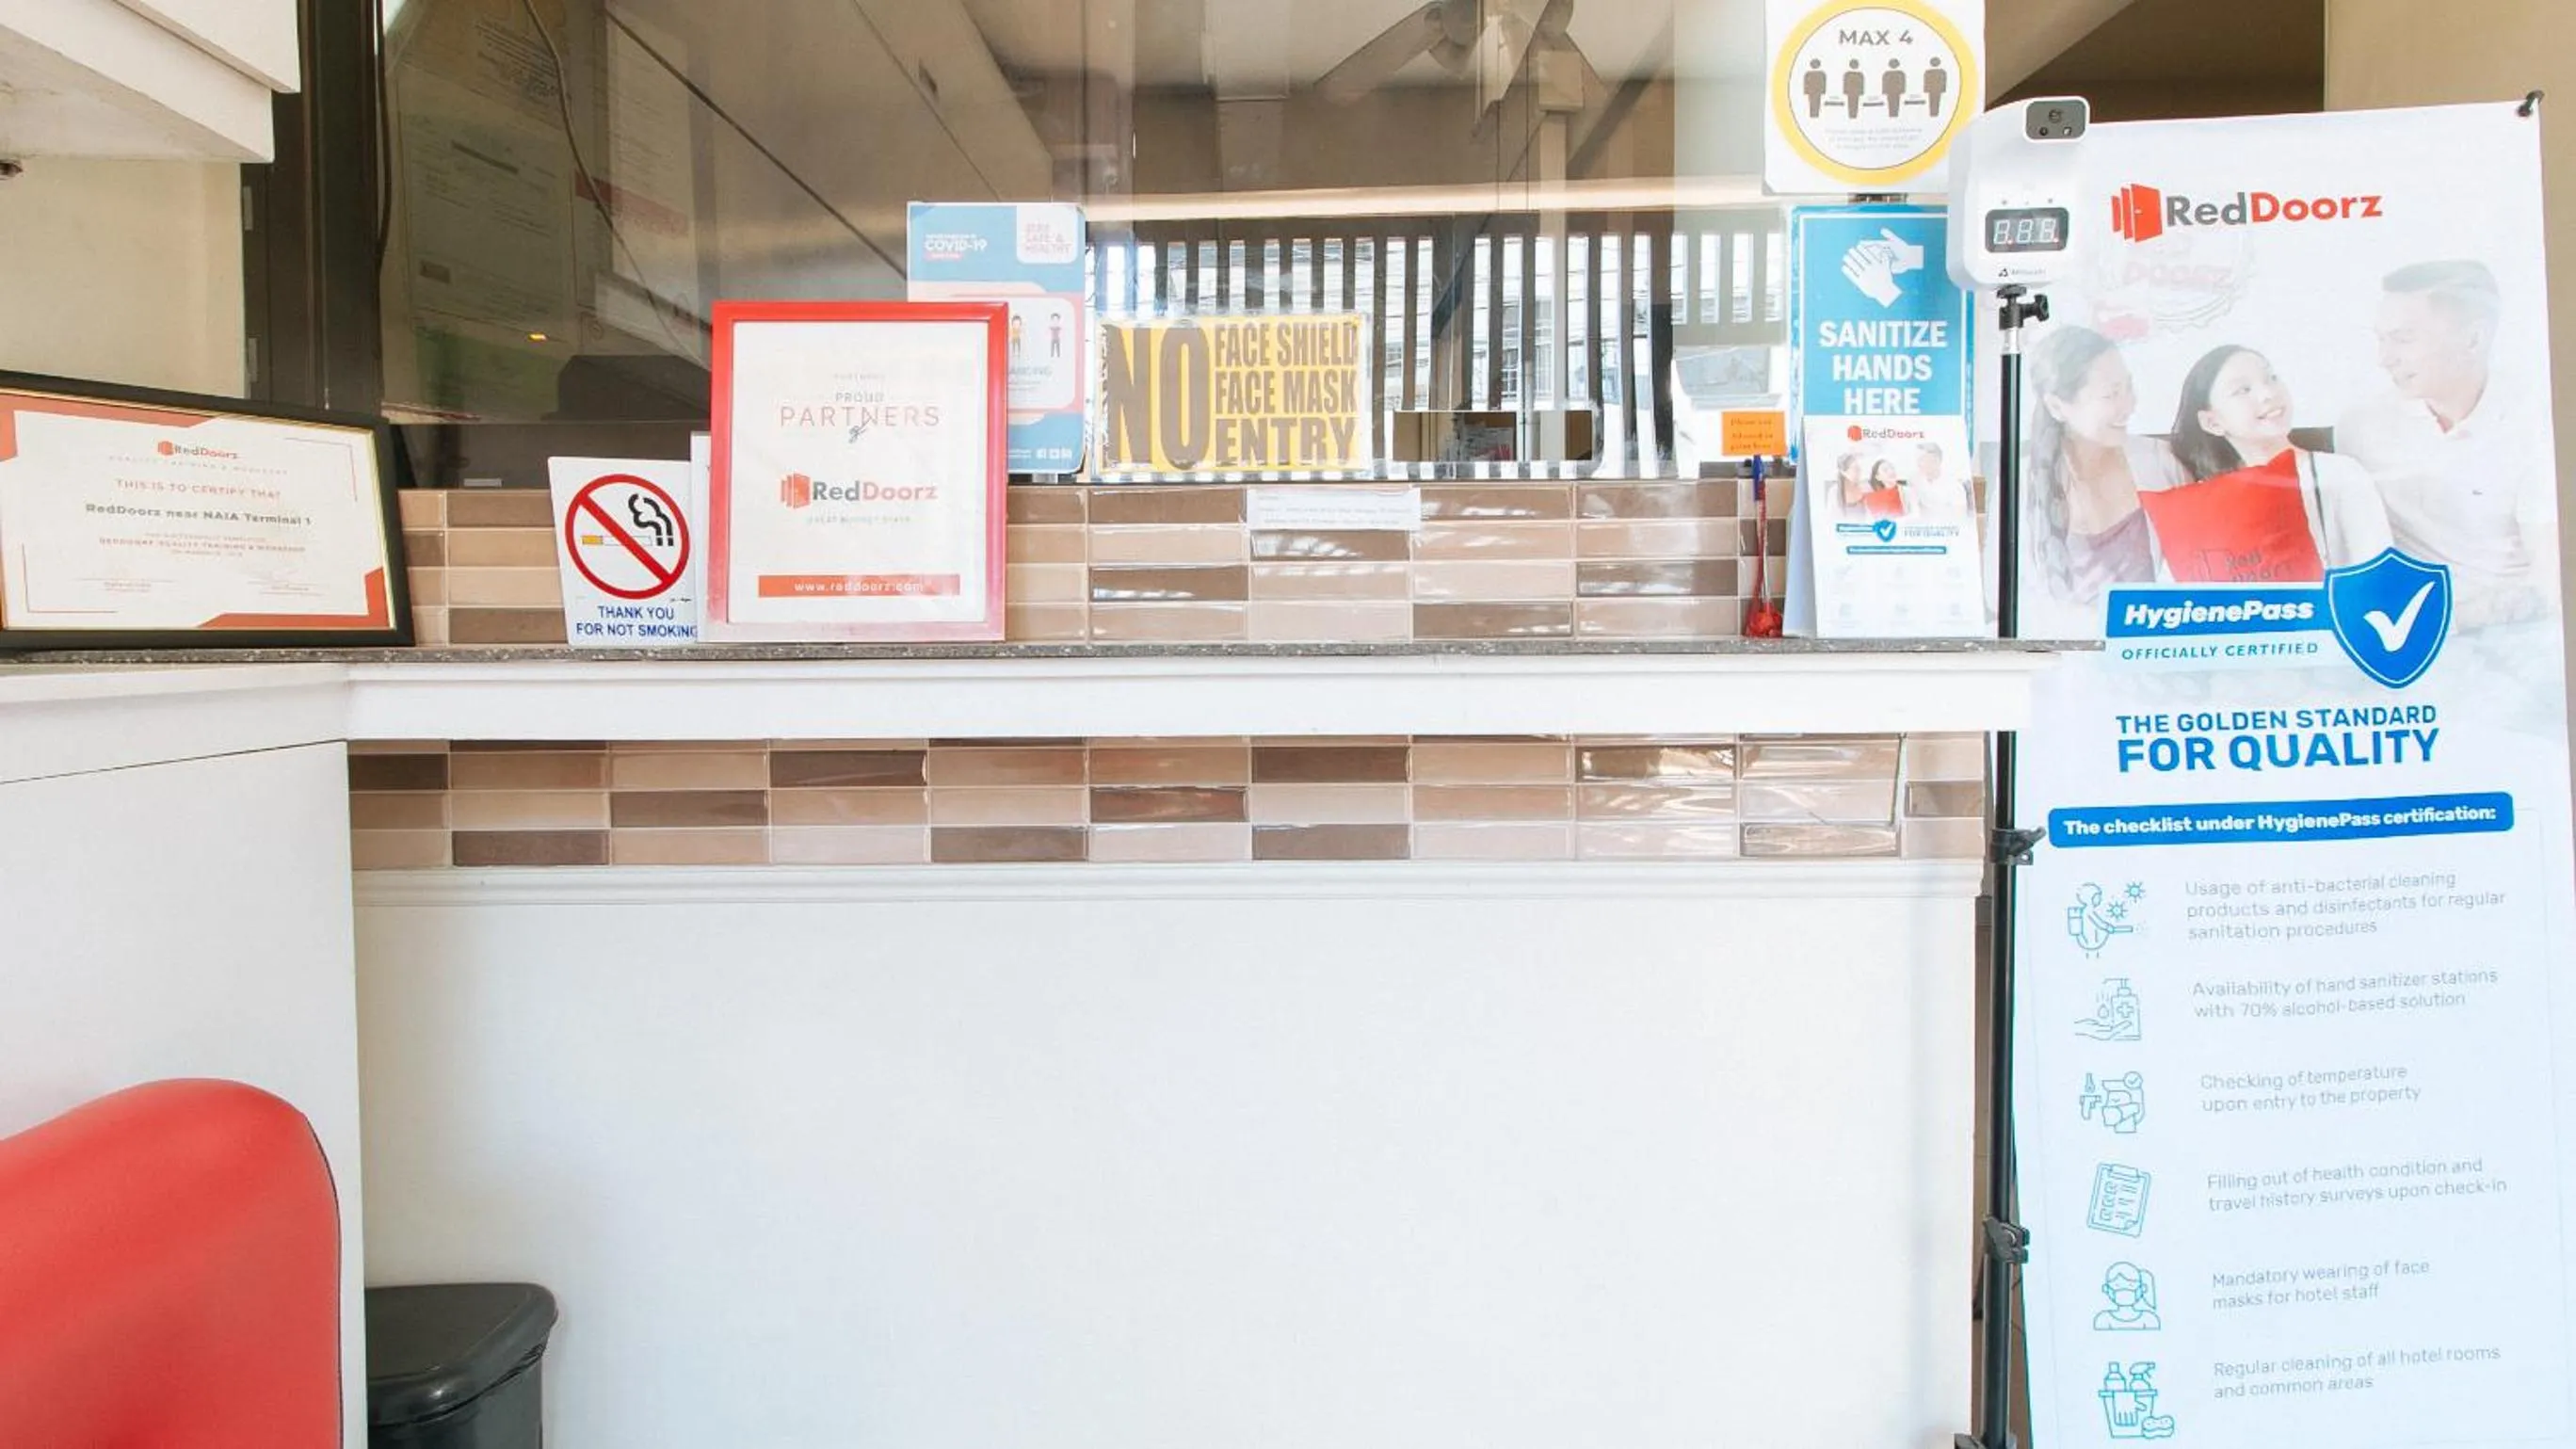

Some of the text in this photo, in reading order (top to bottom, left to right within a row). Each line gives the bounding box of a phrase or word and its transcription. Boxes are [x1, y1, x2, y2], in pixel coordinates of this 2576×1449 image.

[1839, 29, 1914, 46] MAX 4
[2165, 191, 2383, 227] RedDoorz
[925, 237, 987, 251] COVID-19
[1216, 321, 1359, 367] FACE SHIELD
[1819, 321, 1948, 348] SANITIZE
[1832, 354, 1932, 381] HANDS
[835, 391, 885, 403] PROUD
[1102, 319, 1211, 471] NO
[1216, 369, 1359, 415] FACE MASK
[1844, 388, 1921, 415] HERE
[780, 406, 940, 427] PARTNERS
[174, 443, 239, 459] RedDoorz
[1215, 417, 1359, 468] ENTRY
[813, 480, 938, 501] RedDoorz
[86, 504, 161, 517] RedDoorz
[244, 513, 301, 525] Terminal
[795, 581, 924, 592] www.reddoorz.com
[597, 605, 675, 620] THANK YOU
[2125, 600, 2315, 629] HygienePass
[576, 622, 604, 636] FOR
[607, 623, 634, 636] NOT
[2122, 643, 2318, 660] OFFICIALLY CERTIFIED
[2116, 705, 2437, 734] THE GOLDEN STANDARD
[2117, 728, 2440, 772] FOR QUALITY
[2063, 805, 2497, 835] The checklist under HygienePass certification:
[2185, 872, 2456, 899] Usage of anti-bacterial cleaning
[2187, 892, 2505, 919] products and disinfectants for regular
[2188, 920, 2377, 941] sanitation procedures
[2193, 969, 2498, 999] Availability of hand sanitizer stations
[2194, 991, 2465, 1018] with 70% alcohol-based solution
[2200, 1066, 2408, 1090] Checking of temperature
[2202, 1086, 2421, 1113] upon entry to the property
[2207, 1158, 2483, 1191] Filling out of health condition and
[2209, 1178, 2507, 1212] travel history surveys upon check-in
[2213, 1260, 2429, 1288] Mandatory wearing of face
[2213, 1283, 2379, 1310] masks for hotel staff
[2214, 1346, 2501, 1378] Regular cleaning of all hotel rooms
[2214, 1375, 2374, 1399] and common areas
